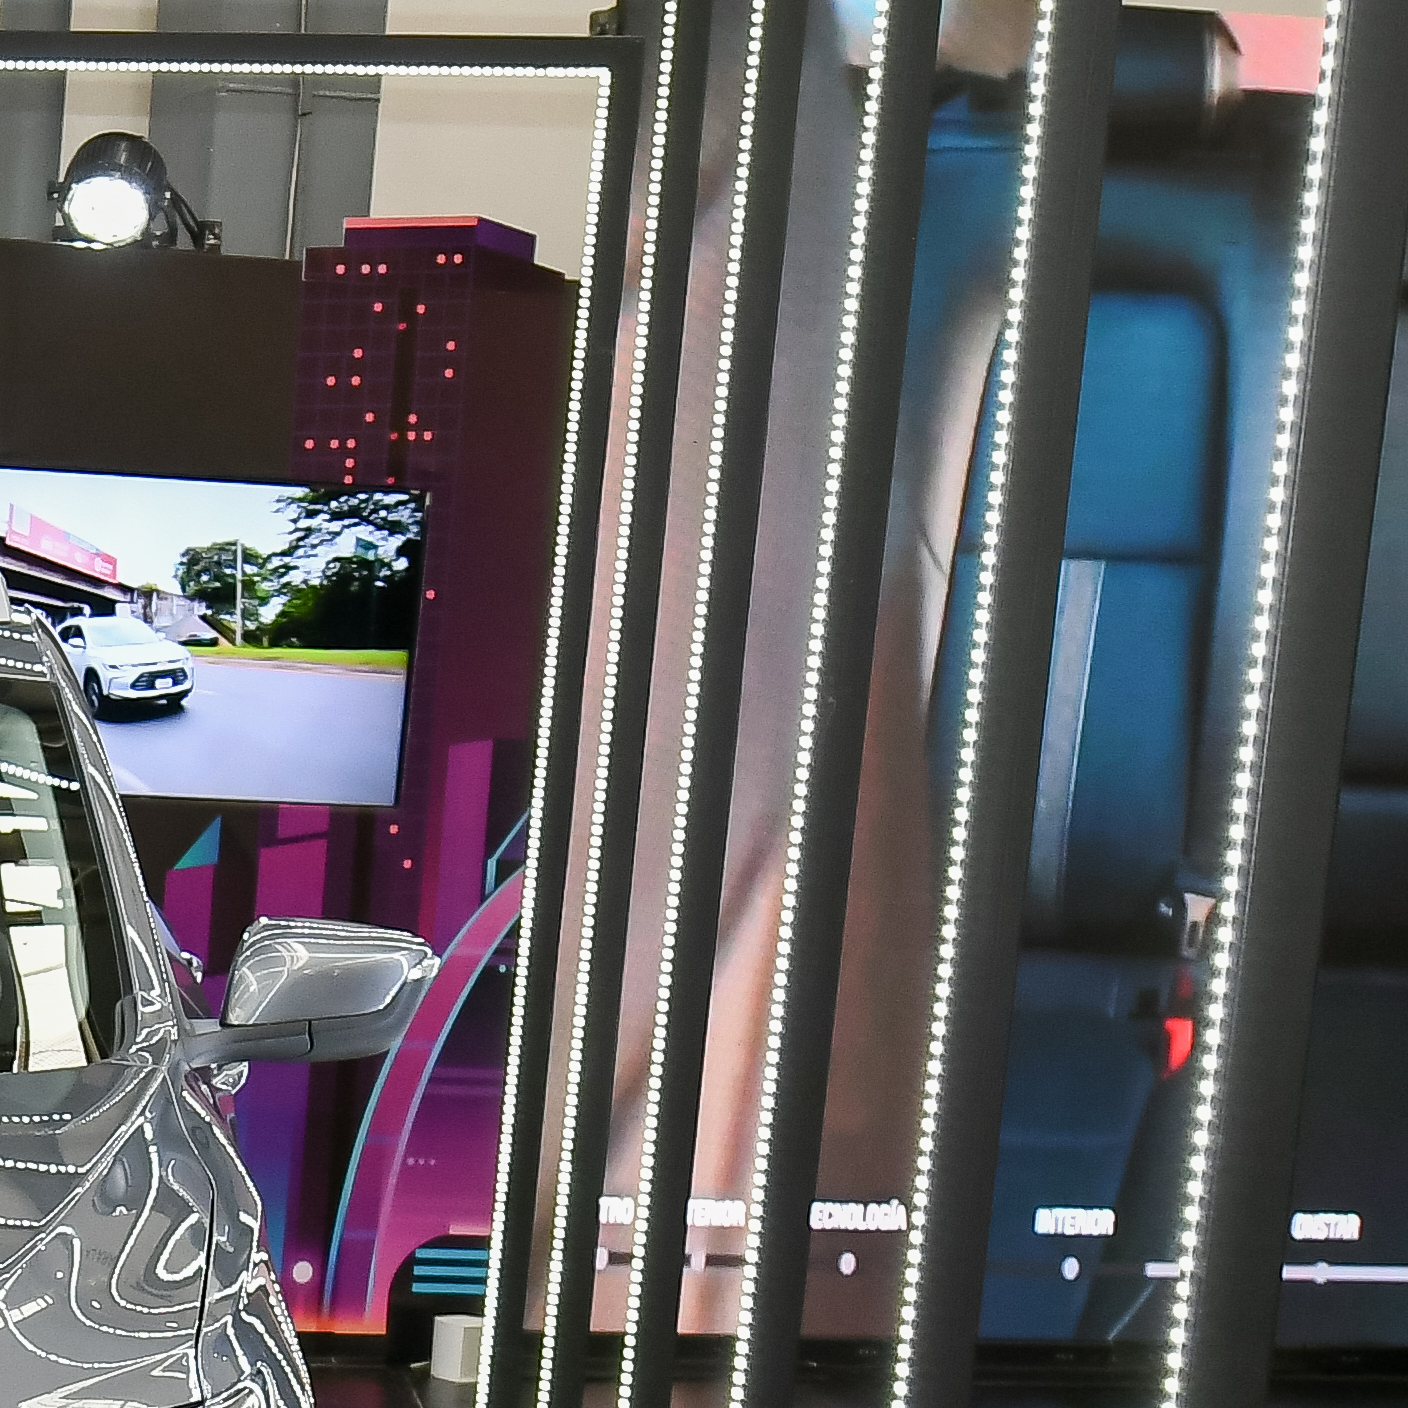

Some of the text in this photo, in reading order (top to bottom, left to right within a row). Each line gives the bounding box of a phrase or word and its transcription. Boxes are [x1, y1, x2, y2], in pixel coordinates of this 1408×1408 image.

[687, 1198, 746, 1227] TERIOR
[810, 1198, 907, 1231] ECNOLOGÍA
[1035, 1207, 1116, 1236] INTERIOR
